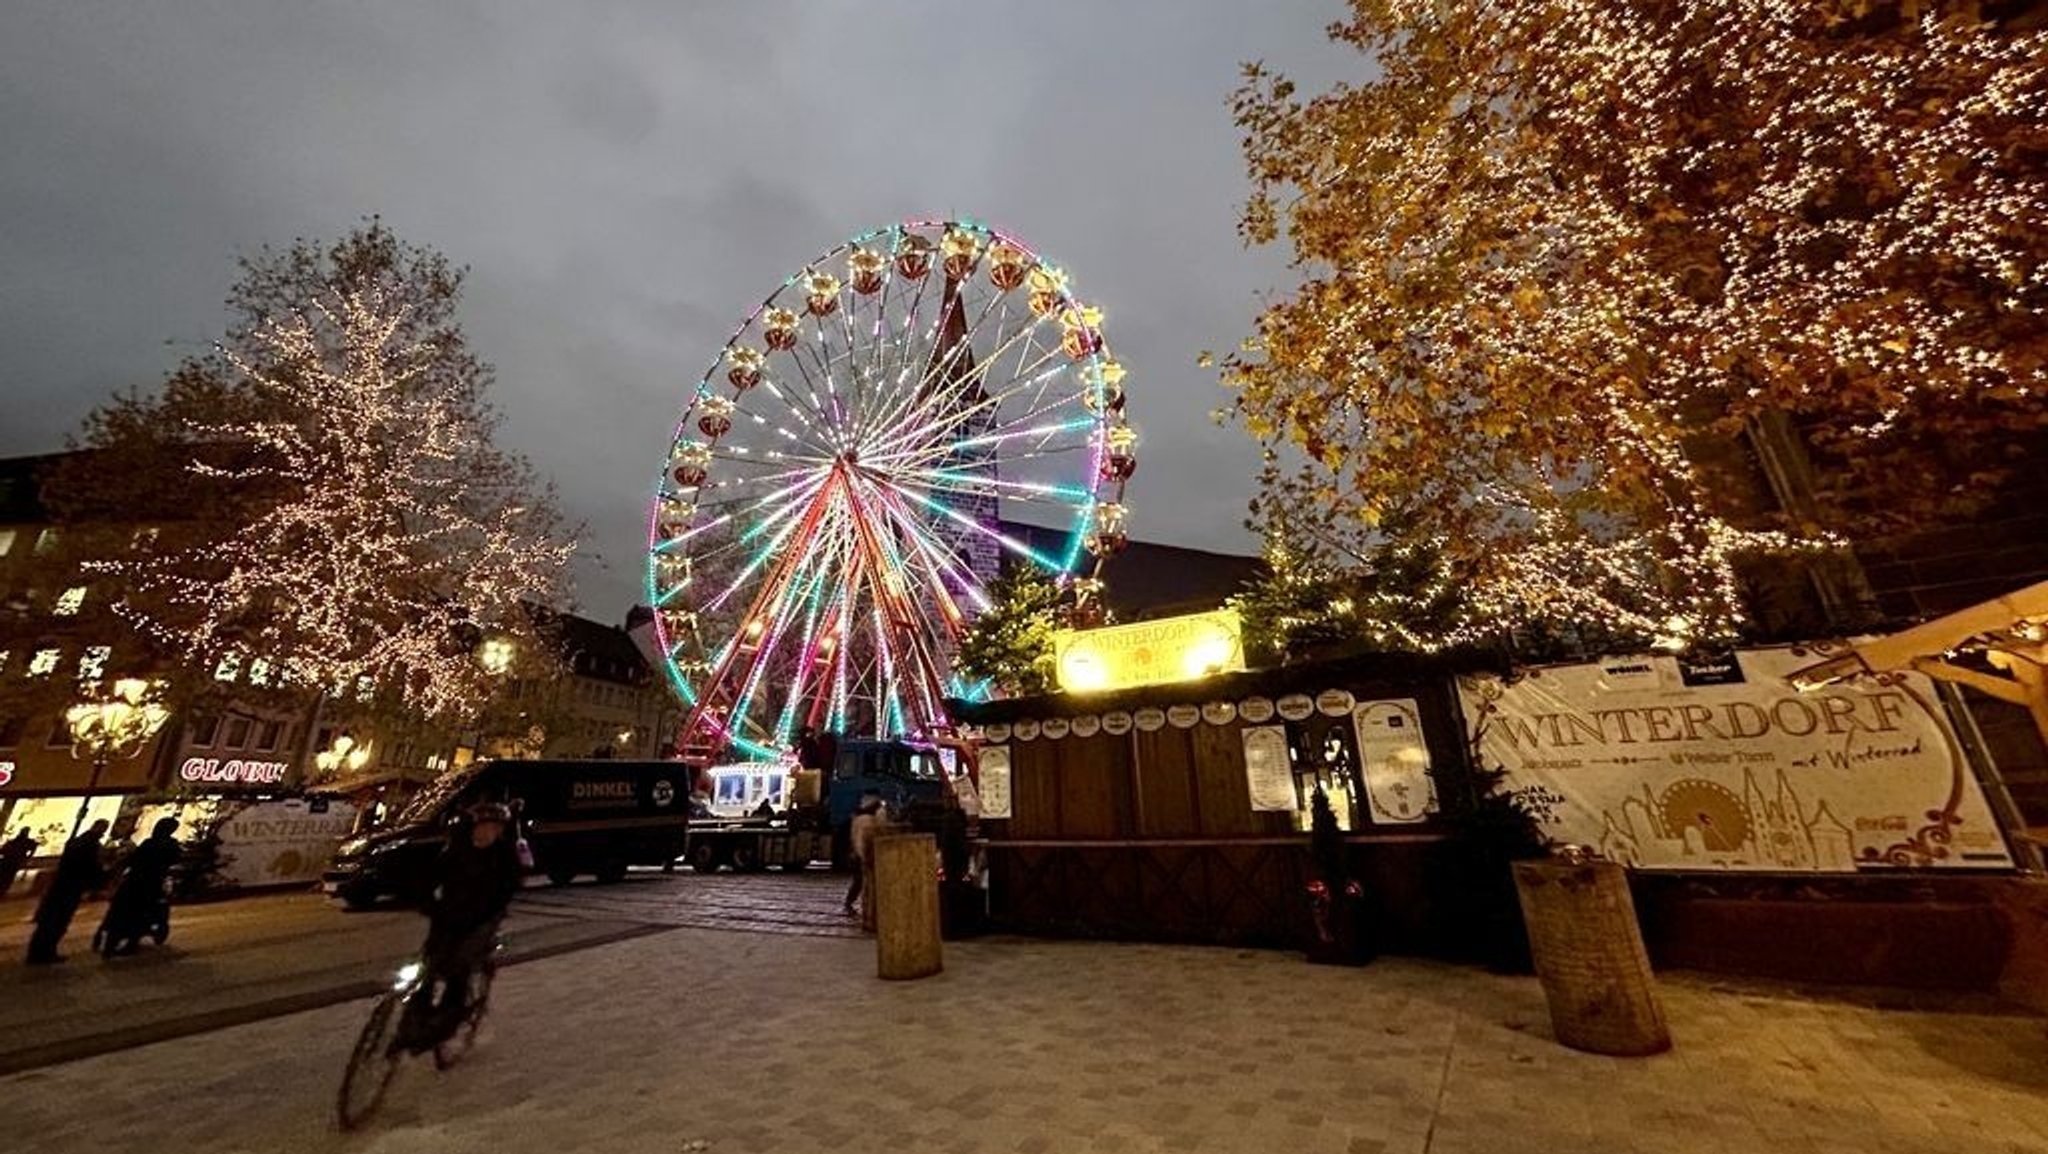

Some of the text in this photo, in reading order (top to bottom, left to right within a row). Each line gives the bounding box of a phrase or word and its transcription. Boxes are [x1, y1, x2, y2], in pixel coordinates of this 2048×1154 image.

[1496, 692, 1905, 748] WINTERDORF
[573, 782, 636, 798] DINKEL
[233, 819, 354, 837] WINTERRA
